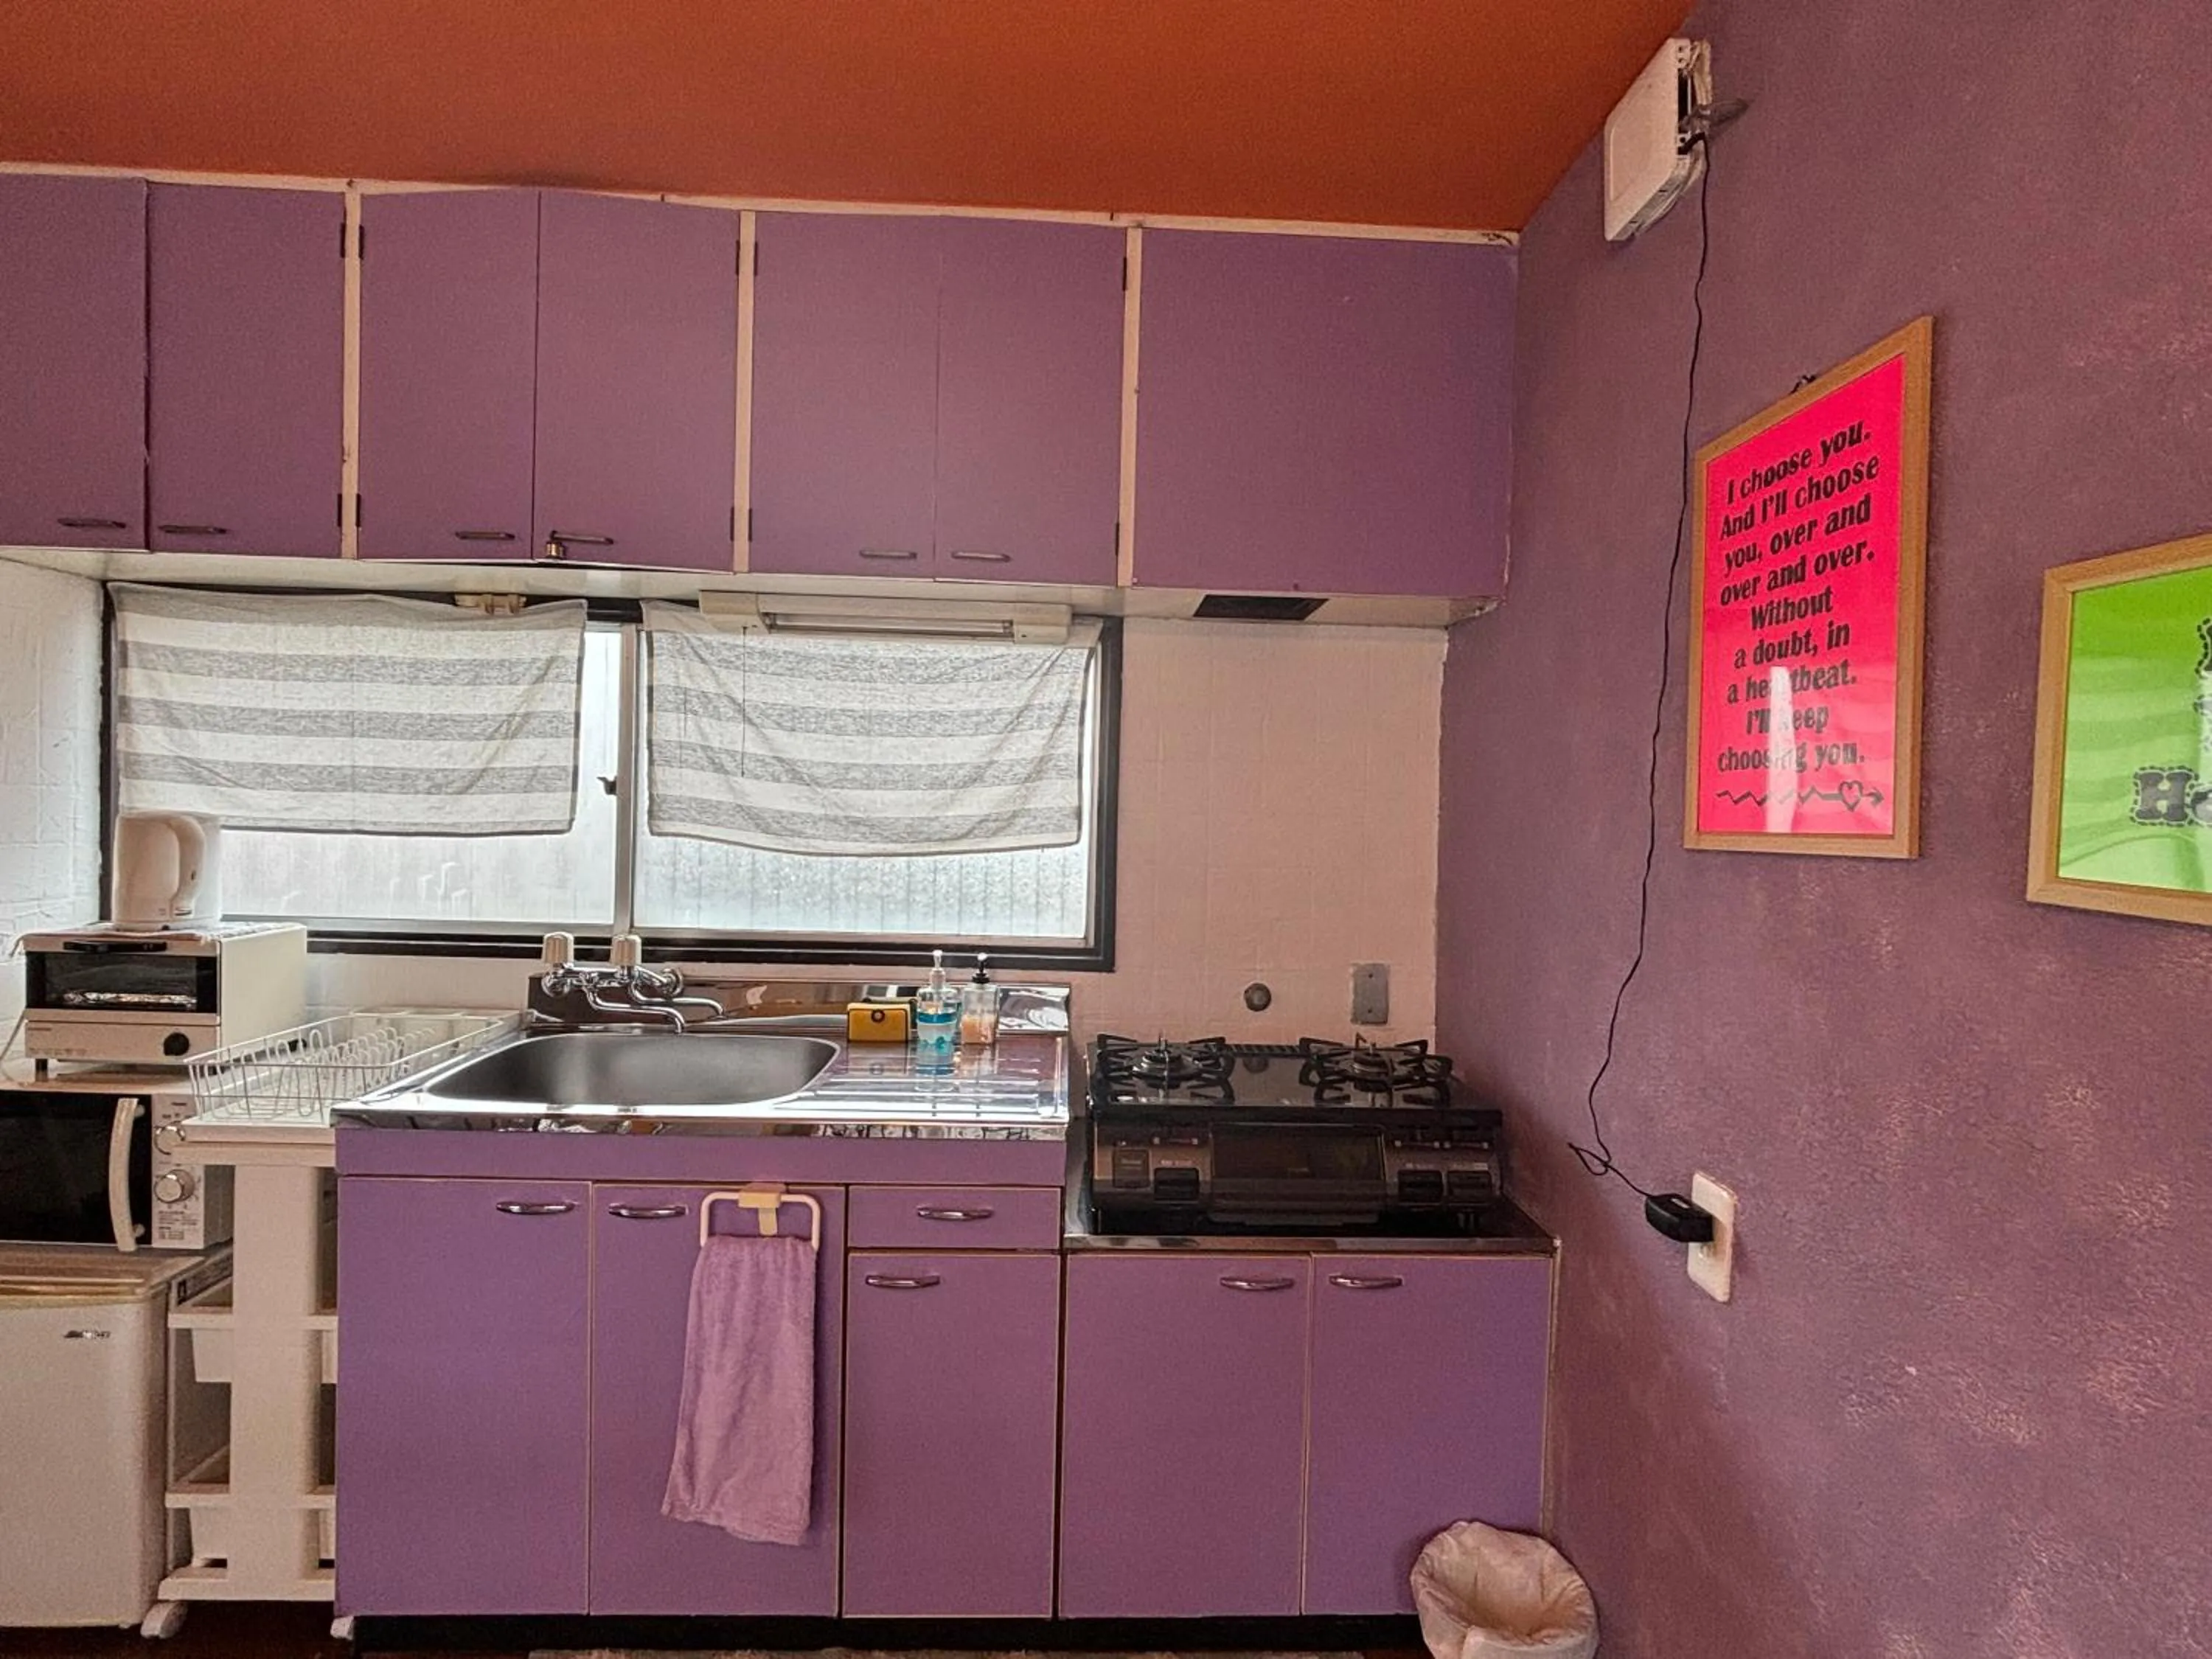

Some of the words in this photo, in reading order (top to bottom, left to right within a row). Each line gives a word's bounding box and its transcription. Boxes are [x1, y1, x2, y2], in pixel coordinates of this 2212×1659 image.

[1727, 479, 1734, 504] I
[1740, 448, 1813, 499] choose
[1819, 421, 1871, 466] you.
[1721, 504, 1755, 540] And
[1761, 490, 1787, 523] I'll
[1795, 456, 1879, 509] choose
[1725, 547, 1762, 577] you,
[1770, 519, 1817, 555] over
[1825, 493, 1871, 535] and
[1720, 579, 1760, 605] over
[1767, 554, 1806, 591] and
[1814, 540, 1875, 574] over.
[1751, 587, 1834, 630] Without
[1734, 648, 1746, 669] a
[1753, 633, 1818, 666] doubt,
[1827, 620, 1851, 650] in
[1728, 684, 1739, 703] a
[1746, 659, 1857, 701] hetbeat.
[1777, 706, 1829, 734] eep
[1815, 742, 1865, 771] you.
